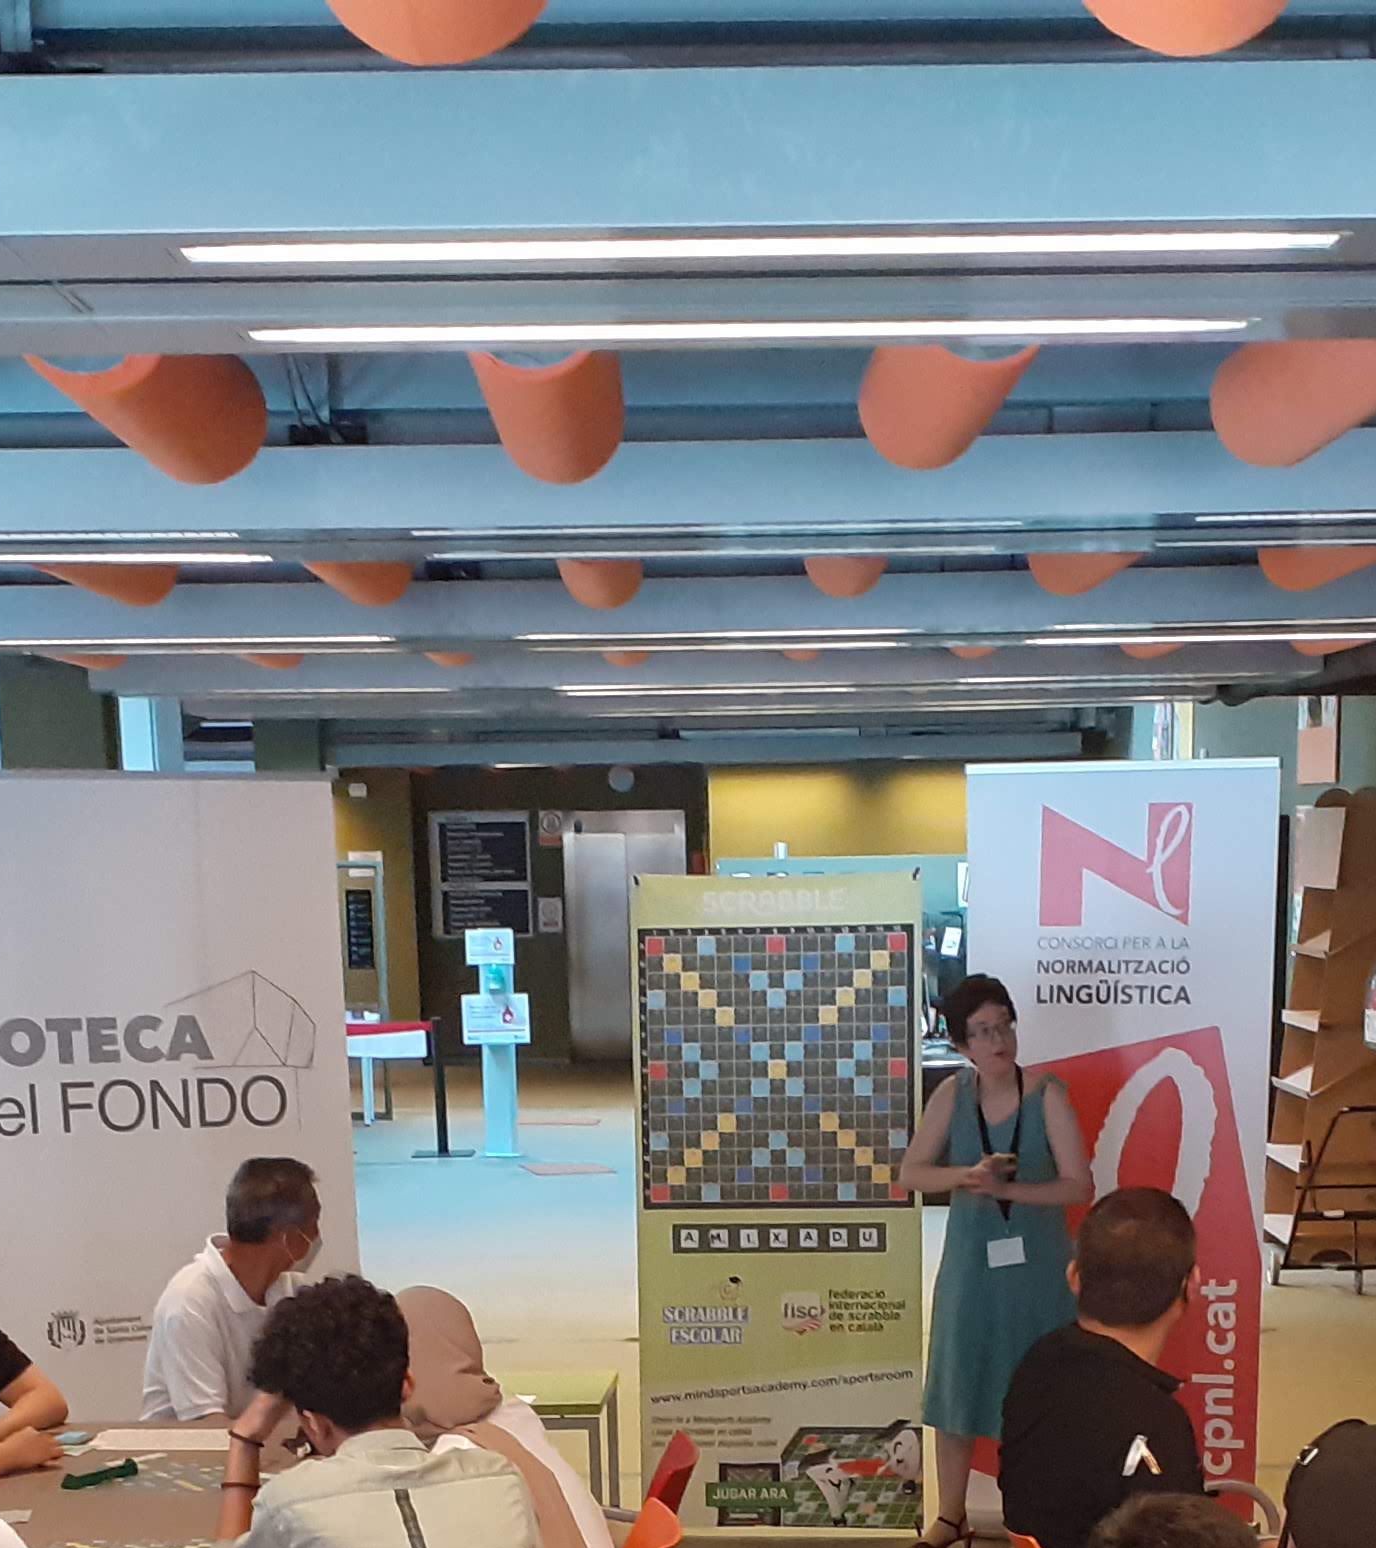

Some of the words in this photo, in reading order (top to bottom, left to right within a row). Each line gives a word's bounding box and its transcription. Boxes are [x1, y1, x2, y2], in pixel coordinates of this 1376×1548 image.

[702, 888, 847, 914] SCRABBLE
[1037, 936, 1118, 951] CONSORCI
[1122, 936, 1152, 951] PER
[1170, 936, 1191, 950] LA
[1036, 956, 1191, 975] NORMALITZACIÓ
[1036, 979, 1192, 1005] LINGÜÍSTICA
[60, 1073, 288, 1135] FONDO
[663, 1306, 749, 1323] SCRABBLE
[670, 1326, 743, 1344] ESCOLAR
[1191, 1278, 1245, 1476] cpnl.cat
[760, 1487, 789, 1500] ARA
